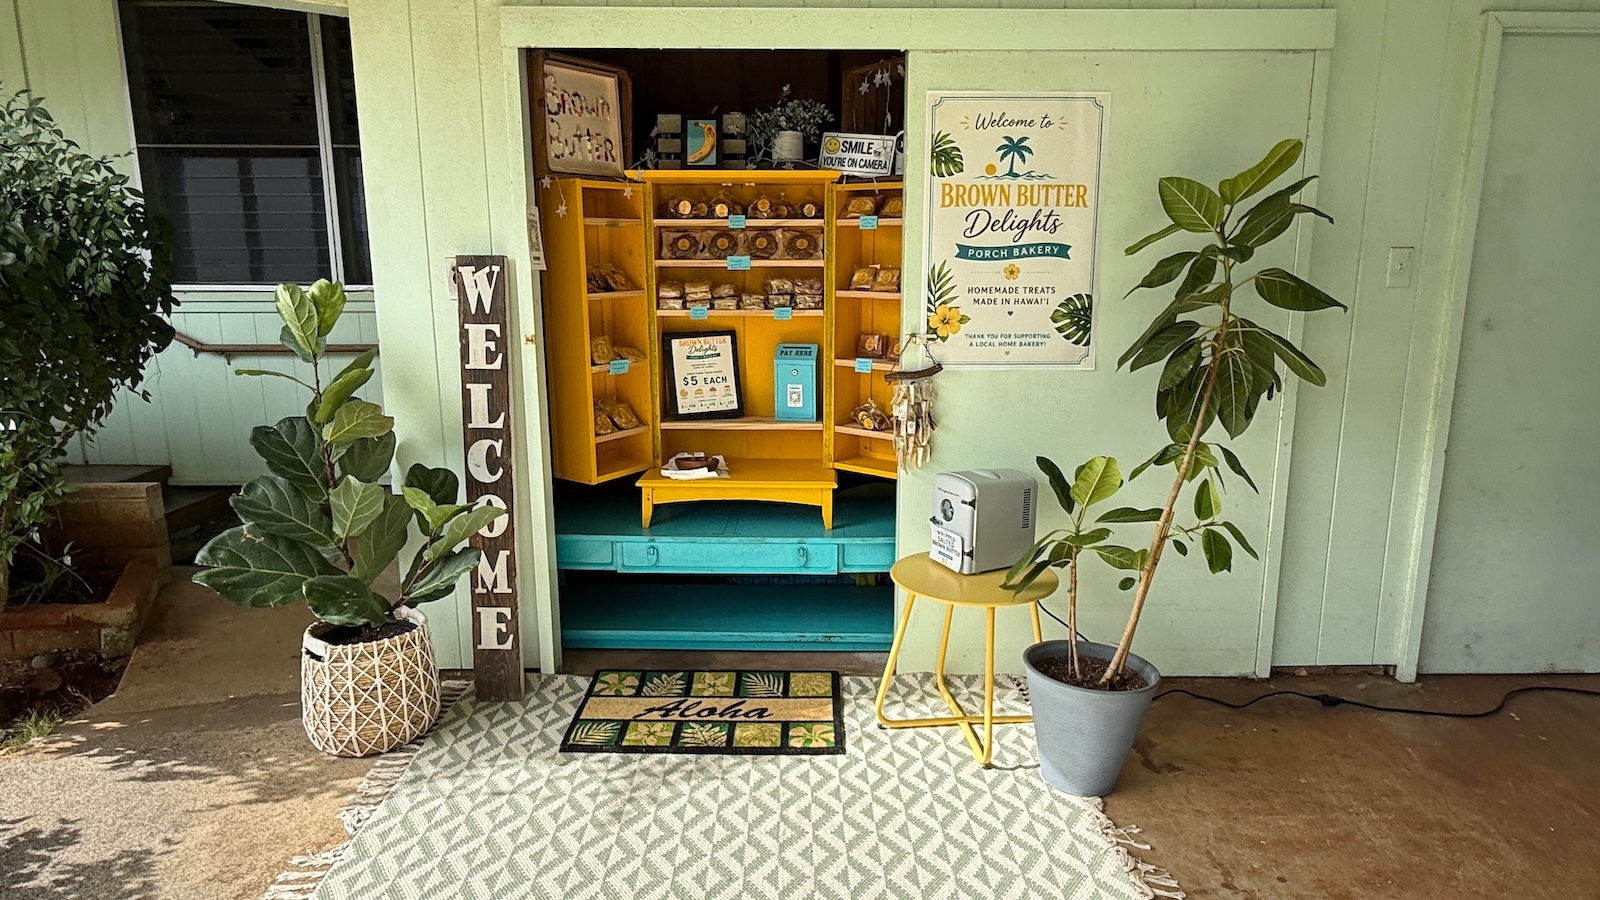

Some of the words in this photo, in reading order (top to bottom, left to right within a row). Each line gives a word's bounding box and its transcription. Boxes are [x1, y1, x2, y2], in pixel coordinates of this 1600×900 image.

[975, 112, 1037, 130] Welcome
[1039, 113, 1055, 129] to
[841, 140, 874, 155] SMILE
[823, 156, 847, 168] YOU'RE
[847, 157, 858, 168] ON
[858, 159, 888, 170] CAMERA
[940, 183, 1011, 208] BROWN
[1016, 184, 1088, 208] BUTTER
[963, 208, 1064, 243] Delights
[968, 248, 1008, 258] PORCH
[1013, 245, 1060, 257] BAKERY
[967, 286, 1019, 295] HOMEMADE
[1023, 286, 1056, 294] TREATS
[973, 297, 998, 306] MADE
[1001, 297, 1010, 306] IN
[703, 336, 727, 346] BUTTER
[688, 344, 718, 355] Delights
[794, 349, 813, 357] HERE
[682, 375, 698, 387] $5
[703, 375, 728, 385] EACH
[457, 265, 514, 650] WELCOME
[932, 539, 946, 552] BROWN
[937, 535, 955, 549] SALTED
[632, 698, 774, 720] Aloha
